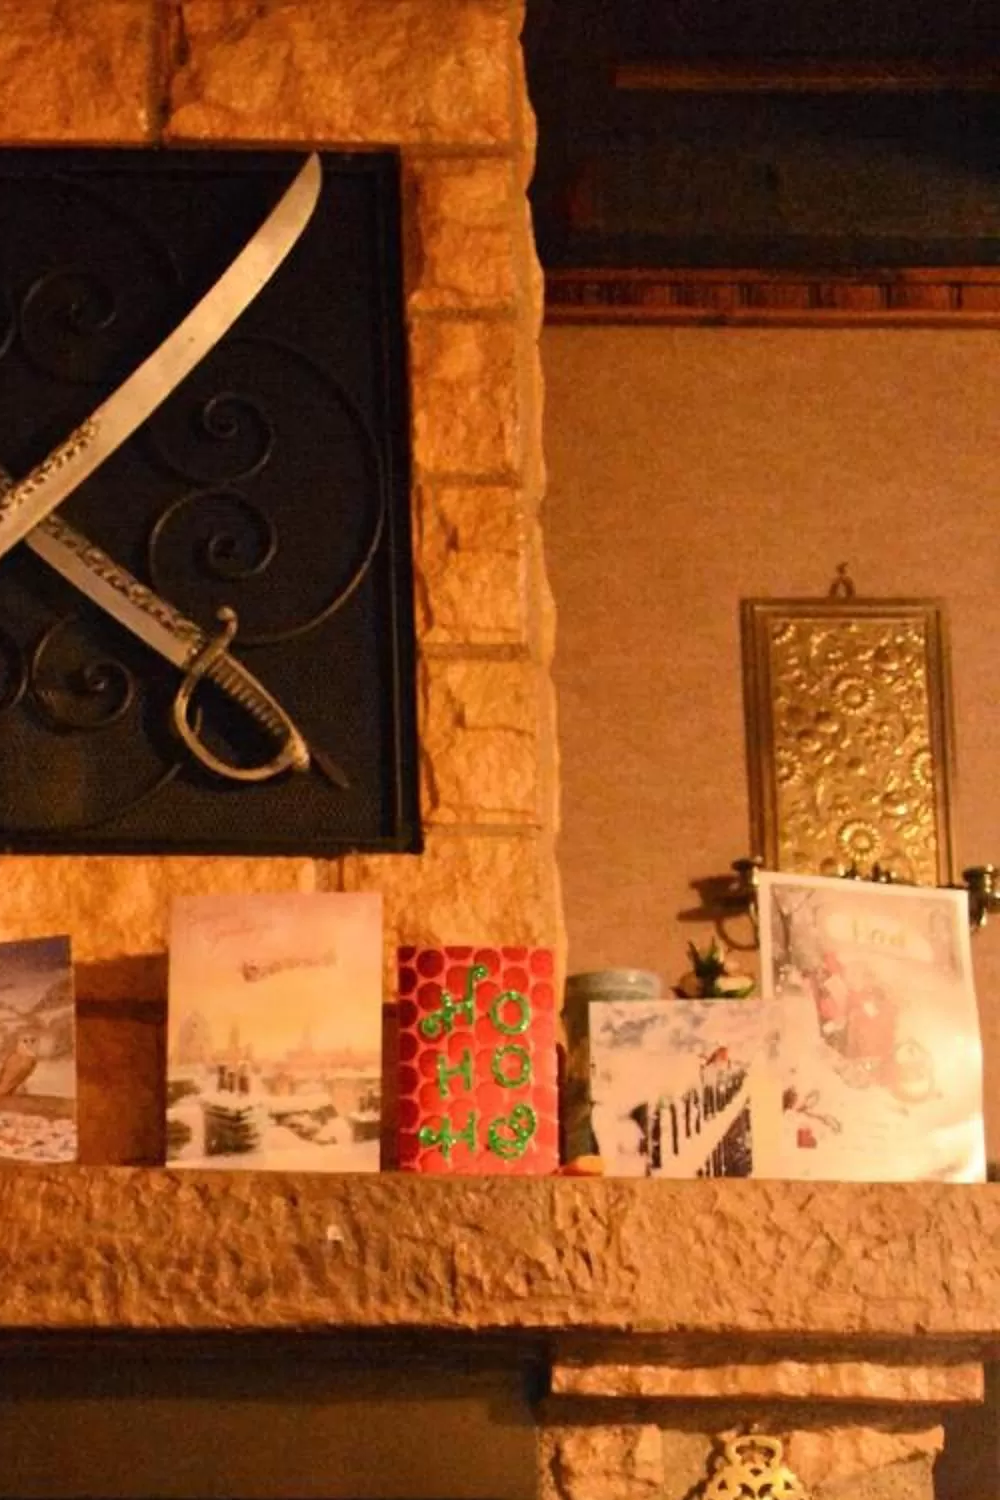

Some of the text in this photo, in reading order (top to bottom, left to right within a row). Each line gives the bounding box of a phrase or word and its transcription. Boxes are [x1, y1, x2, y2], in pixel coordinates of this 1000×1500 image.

[419, 965, 531, 1036] HO
[437, 1044, 531, 1097] HO
[418, 1104, 536, 1160] HO
